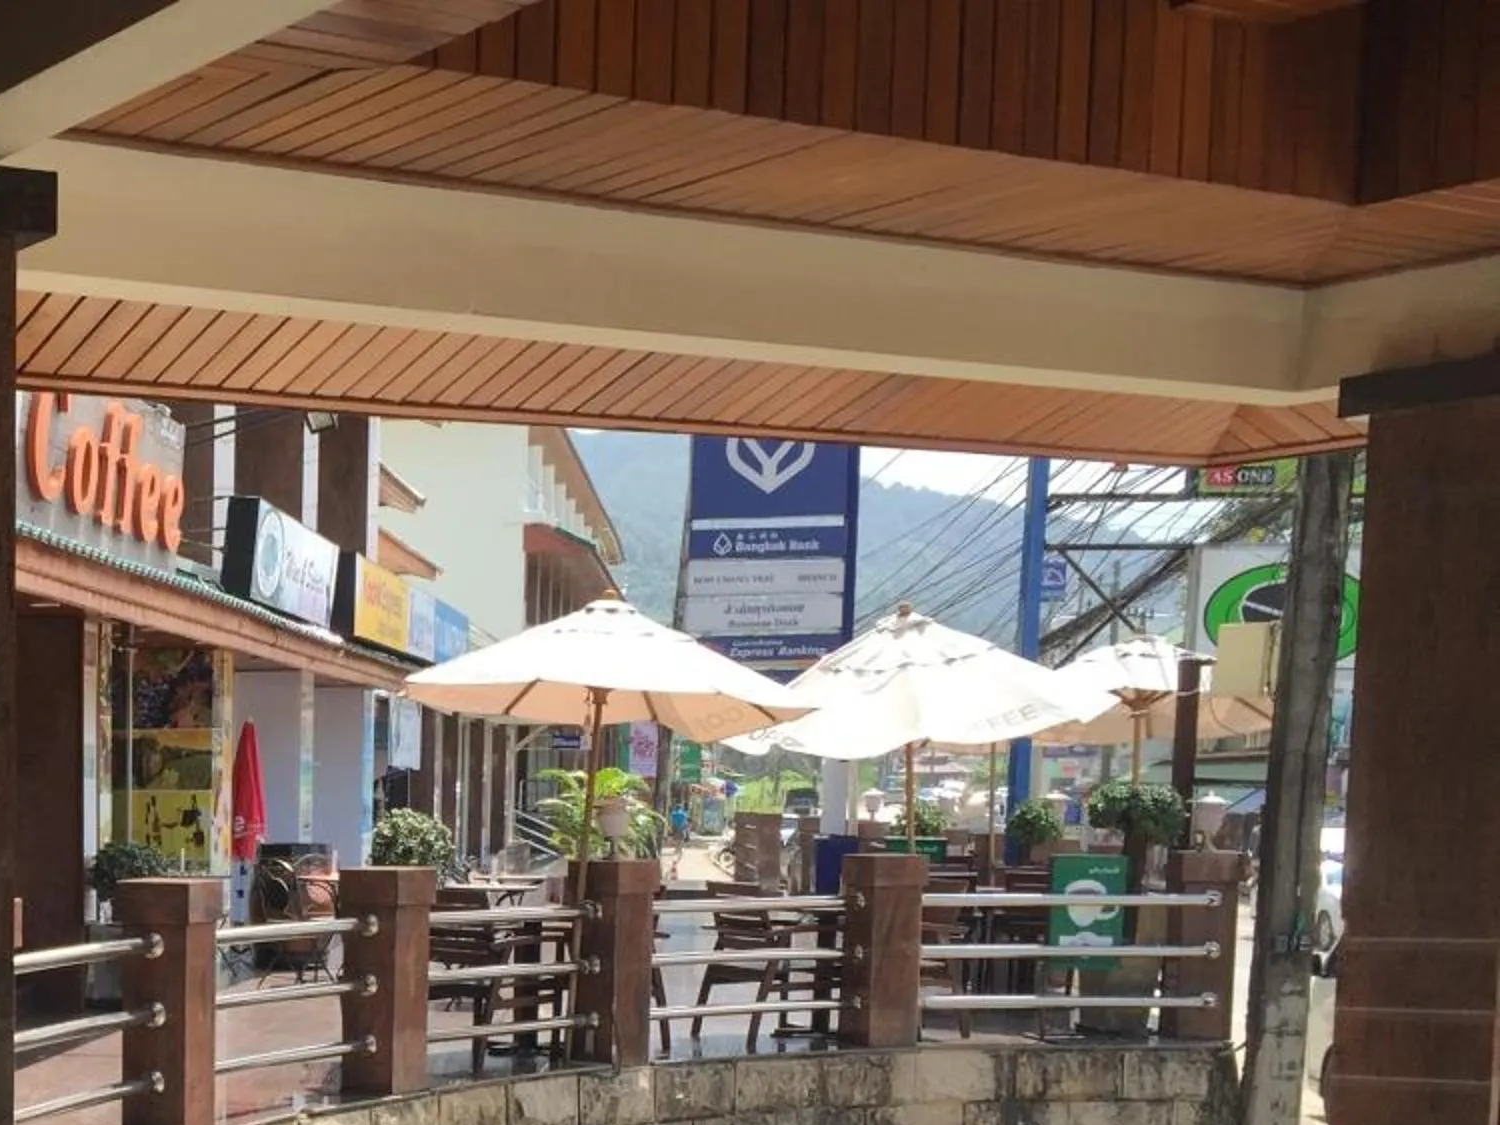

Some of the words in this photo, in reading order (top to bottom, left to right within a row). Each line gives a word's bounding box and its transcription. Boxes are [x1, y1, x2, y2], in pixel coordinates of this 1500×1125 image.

[28, 387, 184, 552] Coffee
[735, 540, 787, 553] Bangkok
[789, 538, 820, 551] Bank
[730, 647, 775, 659] Express
[777, 645, 828, 657] Banking
